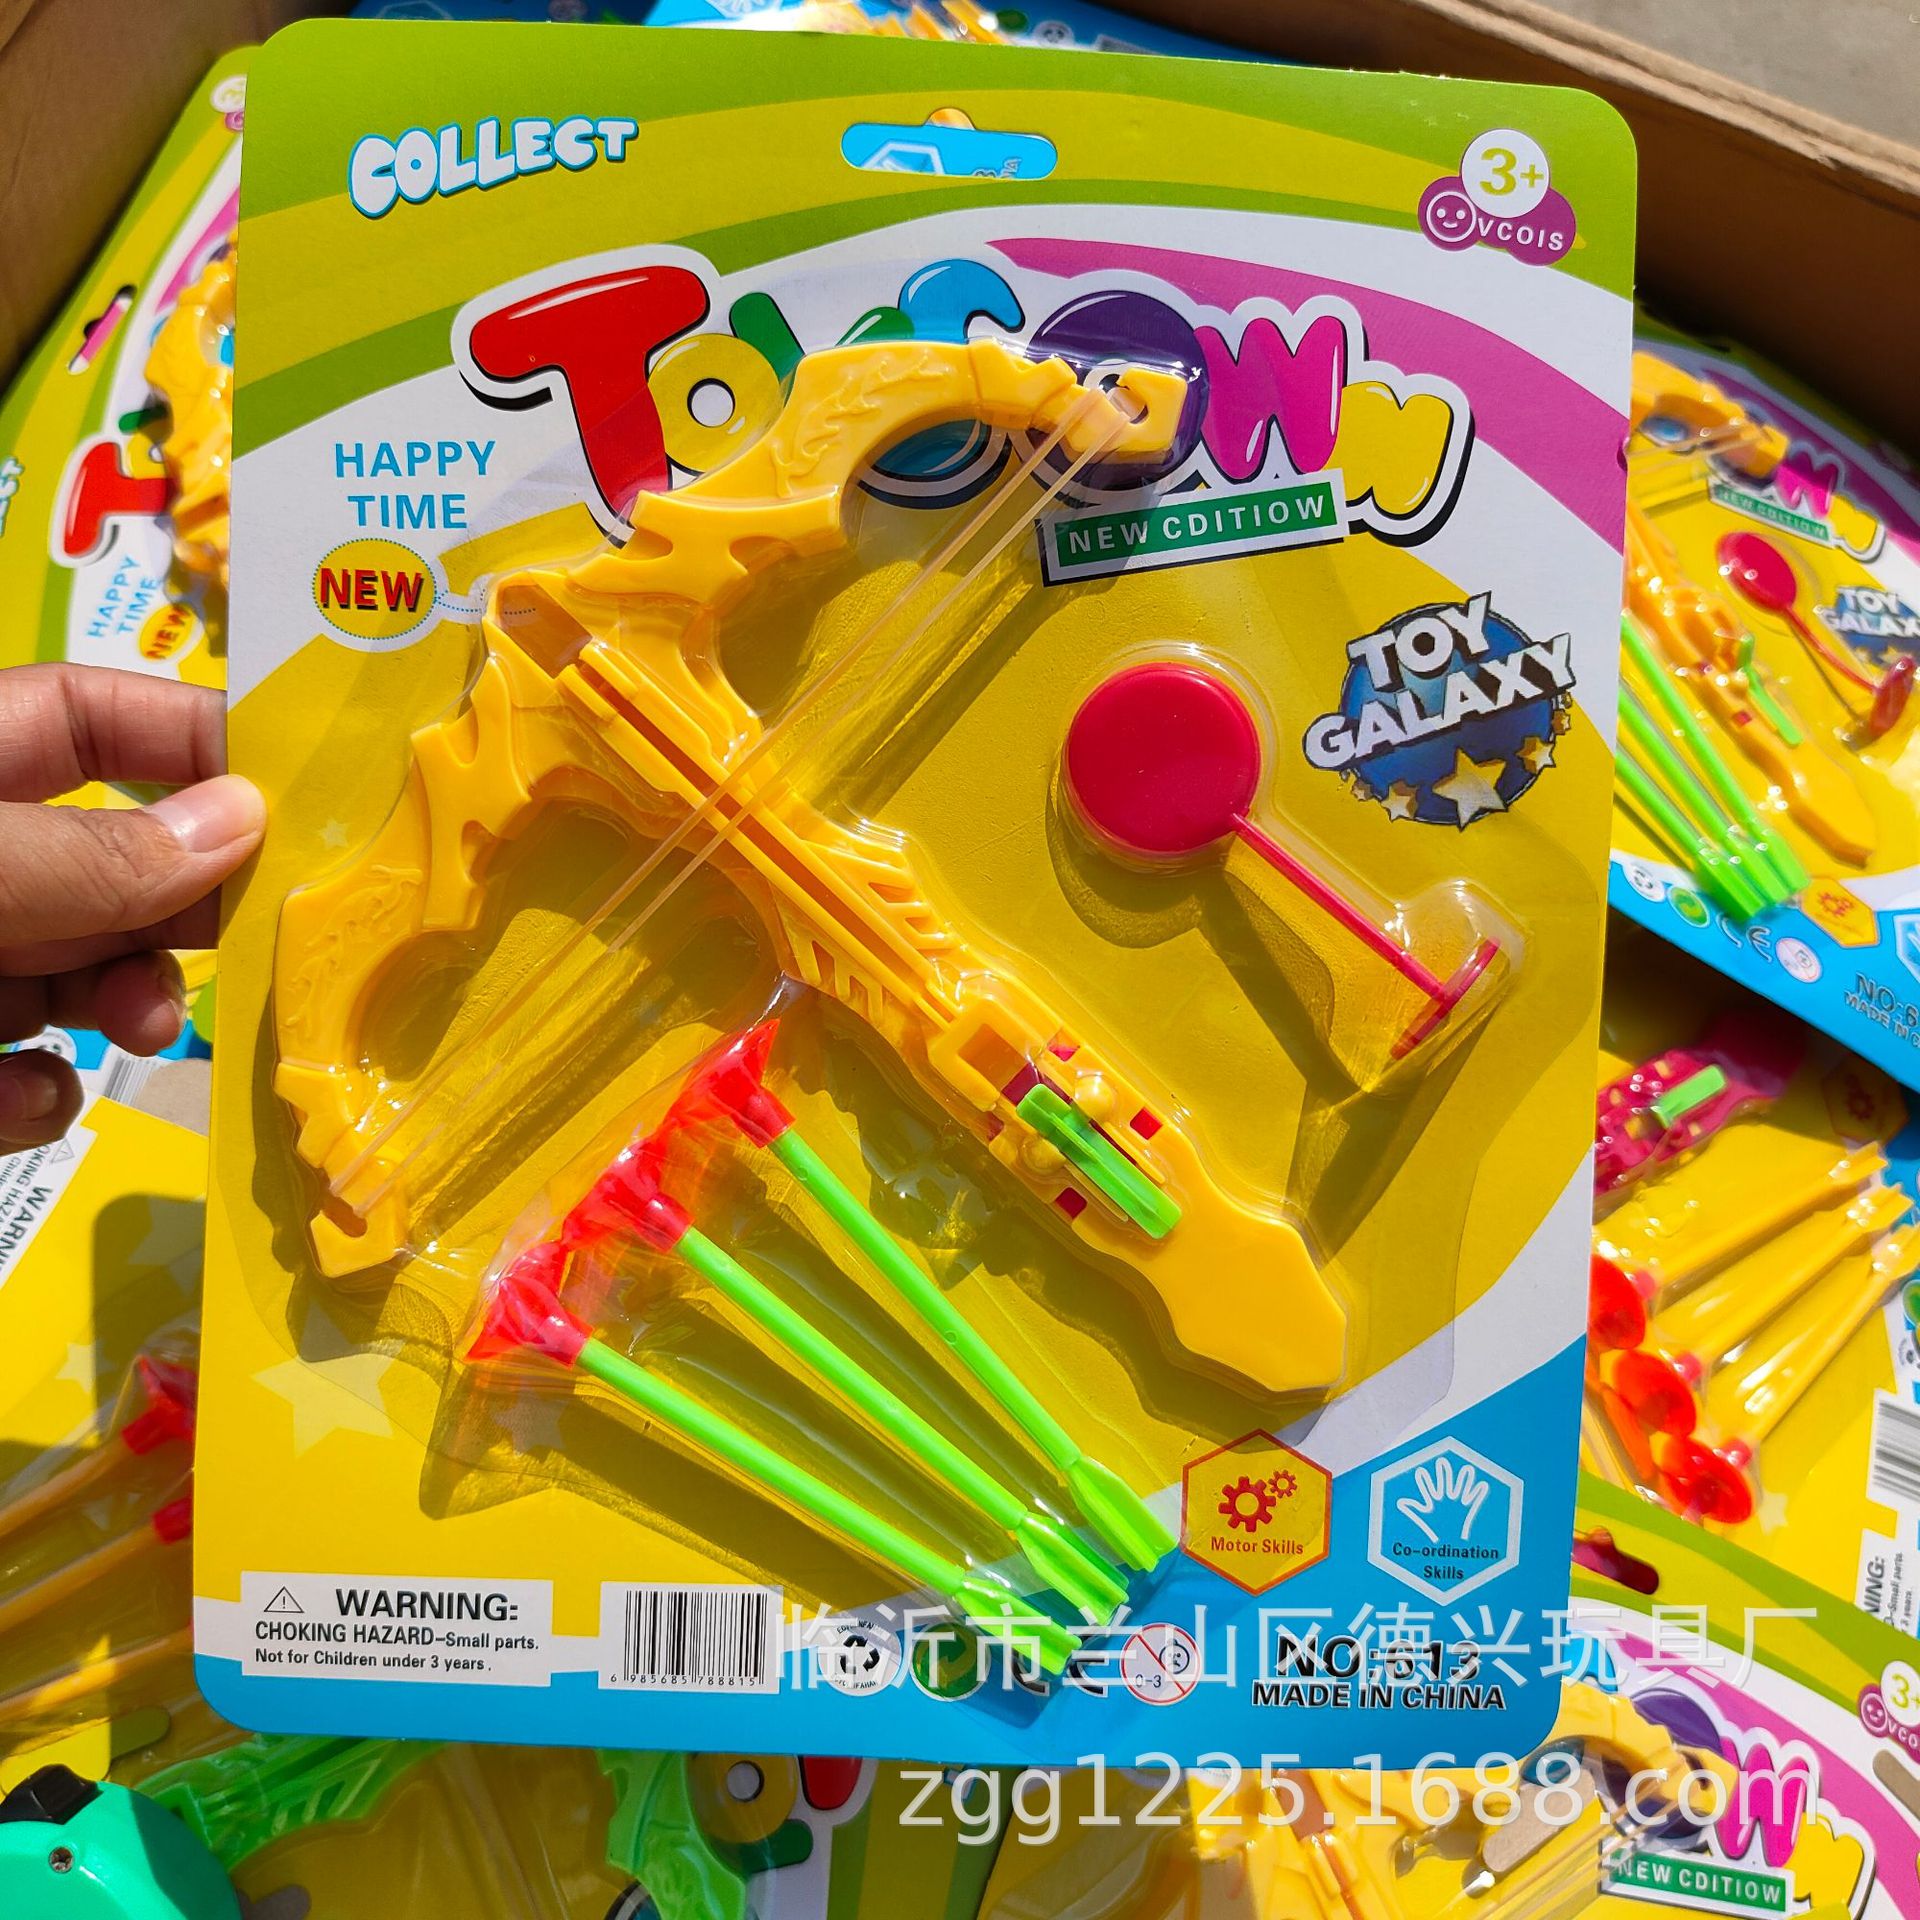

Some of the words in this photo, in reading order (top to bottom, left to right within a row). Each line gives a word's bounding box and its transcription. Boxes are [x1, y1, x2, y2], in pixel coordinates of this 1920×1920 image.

[348, 115, 639, 219] COLLECT
[1479, 147, 1545, 196] 3+
[1477, 217, 1564, 251] VCOIS
[335, 440, 496, 478] HAPPY
[347, 493, 468, 530] TIME
[1068, 519, 1149, 554] NEW
[1162, 494, 1325, 541] CDITIOW
[87, 554, 141, 638] HAPPY
[117, 576, 163, 635] TIME
[319, 567, 424, 613] NEW
[1836, 585, 1904, 615] TOY
[145, 602, 192, 660] NEW
[1346, 591, 1491, 692] TOY
[1822, 608, 1920, 637] GALAX
[1302, 632, 1577, 771] GALAXY
[1844, 989, 1891, 1029] MADE
[16, 1143, 51, 1187] OKING
[1211, 1536, 1257, 1553] Motor
[1261, 1538, 1304, 1555] Skills
[1392, 1542, 1499, 1560] Co-ordination
[1423, 1564, 1464, 1581] Skills
[335, 1587, 518, 1622] WARNING:
[255, 1620, 346, 1643] CHOKING
[495, 1634, 540, 1651] parts.
[255, 1648, 282, 1664] Not
[287, 1650, 308, 1665] for
[314, 1651, 377, 1667] Children
[382, 1653, 425, 1669] under
[430, 1655, 439, 1669] 3
[1251, 1680, 1352, 1708] MADE
[1360, 1682, 1396, 1709] IN
[1401, 1684, 1507, 1711] CHINA
[1888, 1719, 1920, 1750] VCO
[1617, 1860, 1672, 1885] NEW
[1679, 1868, 1781, 1905] CDITIOW
